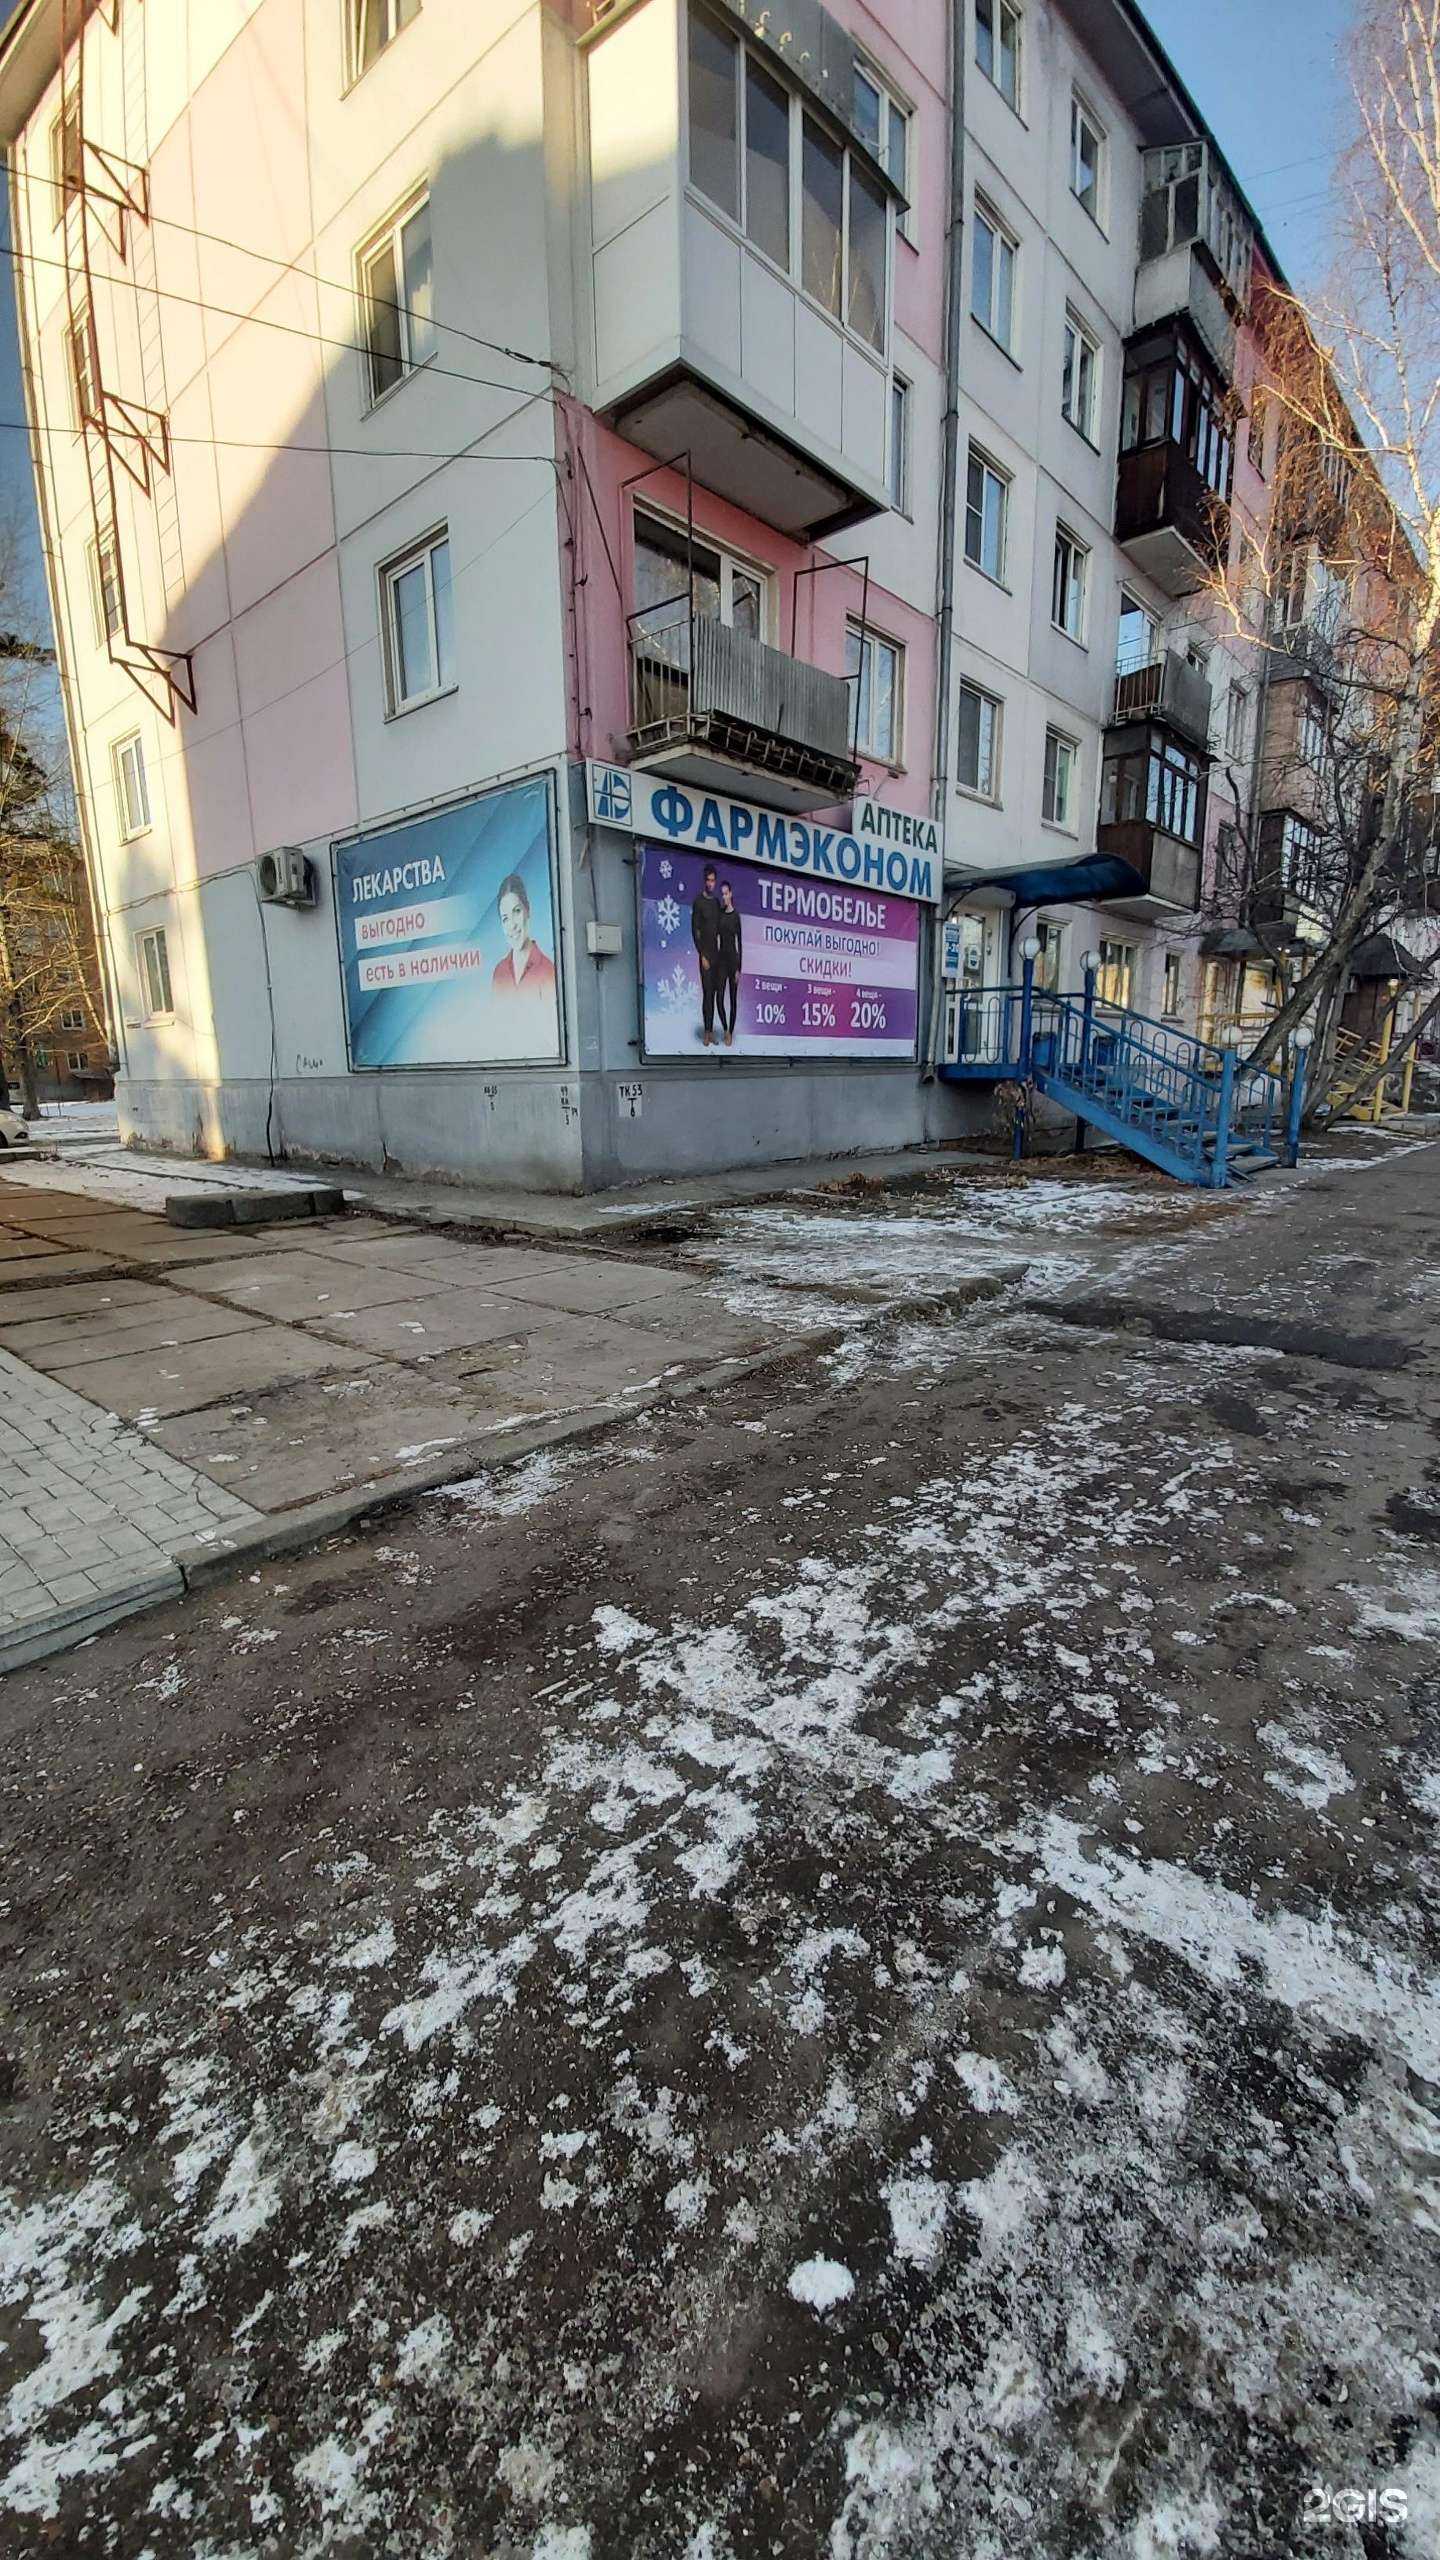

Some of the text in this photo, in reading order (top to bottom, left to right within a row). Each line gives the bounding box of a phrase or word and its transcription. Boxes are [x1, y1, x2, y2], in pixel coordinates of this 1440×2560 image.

[650, 785, 933, 898] ФАРМЭКОНОМ
[860, 801, 938, 854] АПТЕКА
[352, 855, 446, 903] ЛЕКАРСТВА
[758, 879, 887, 930] ТЕРМОБЕЛЬЕ
[765, 925, 880, 956] ПОКУПАЙ ВЫГОДНО!
[366, 964, 395, 982] есть
[410, 949, 480, 977] наличии
[799, 957, 852, 979] СКИДКИ!
[754, 978, 761, 990] 2
[807, 983, 813, 994] 3
[755, 1003, 786, 1025] 10%
[801, 1002, 836, 1028] 15%
[850, 1001, 887, 1030] 20%
